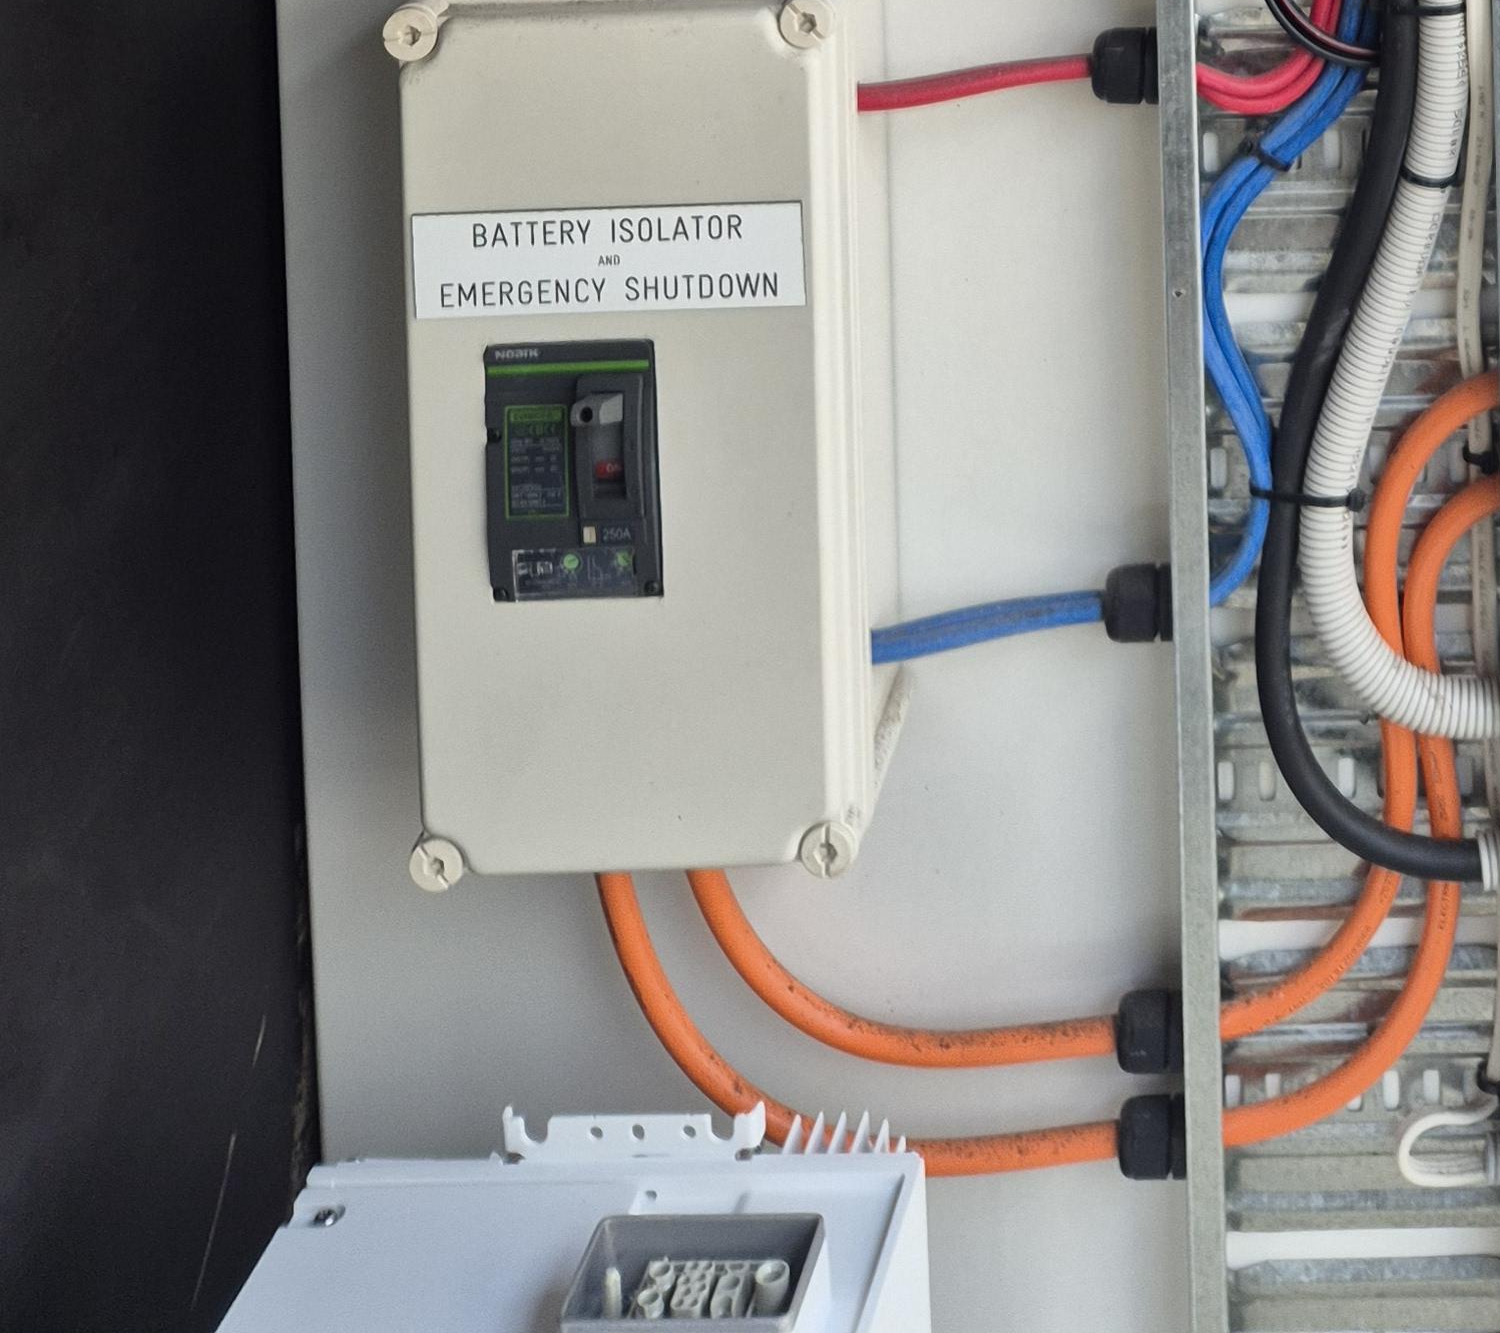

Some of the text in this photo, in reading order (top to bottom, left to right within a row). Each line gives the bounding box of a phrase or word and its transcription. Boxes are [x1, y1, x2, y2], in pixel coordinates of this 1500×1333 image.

[472, 214, 743, 248] BATTERY ISOLATOR
[598, 255, 621, 266] AND
[440, 272, 779, 308] EMERGENCY SHUTDOWN
[602, 528, 632, 541] 250A
